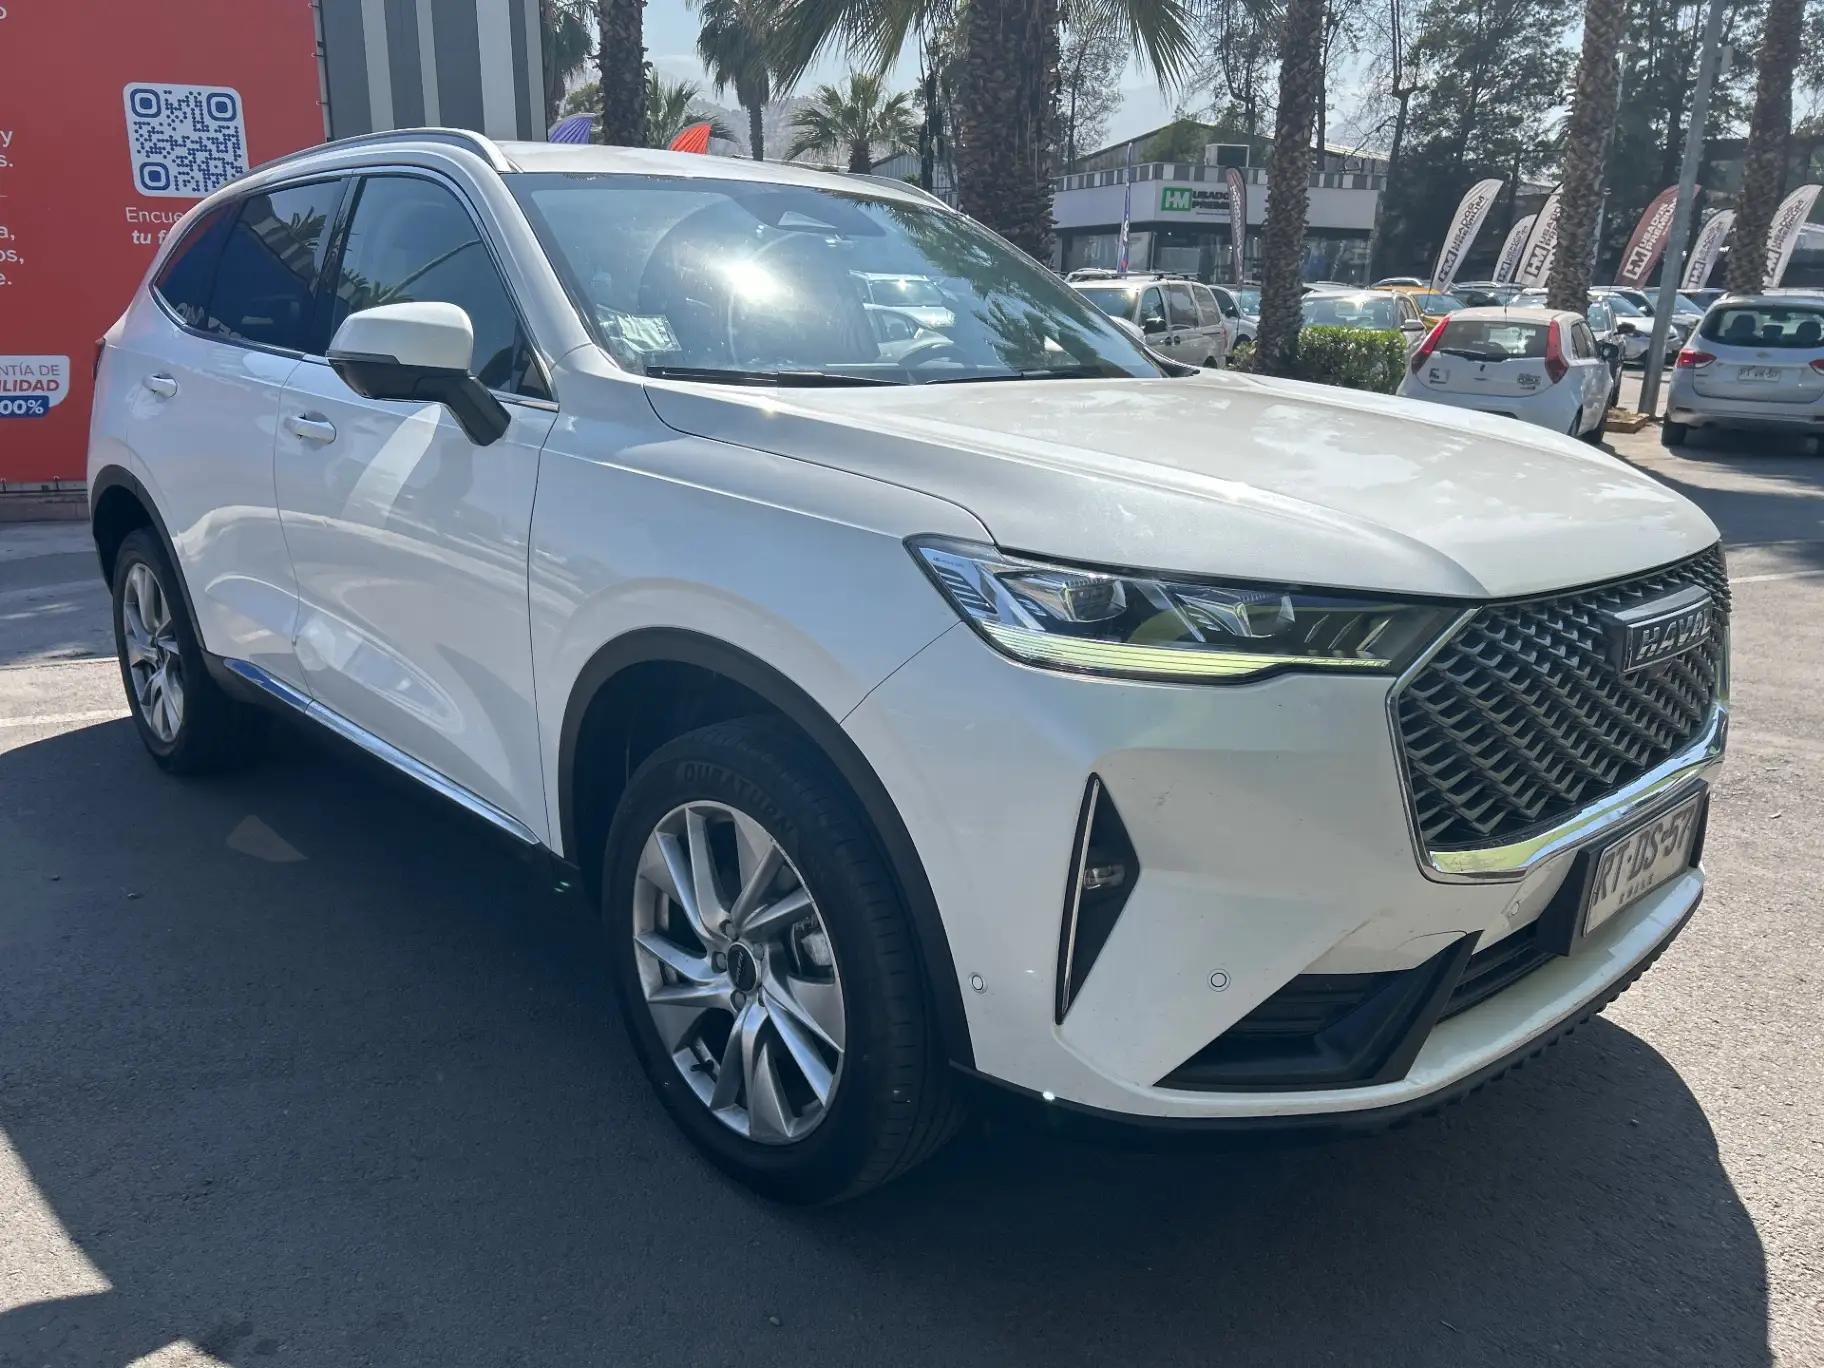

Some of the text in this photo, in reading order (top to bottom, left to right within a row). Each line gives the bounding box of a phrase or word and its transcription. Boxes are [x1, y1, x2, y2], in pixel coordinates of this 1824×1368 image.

[1165, 190, 1190, 209] HM
[132, 230, 152, 244] tu
[1525, 246, 1548, 276] HM
[1625, 250, 1648, 277] HM
[39, 365, 60, 376] DE
[1636, 608, 1711, 660] HAVAL
